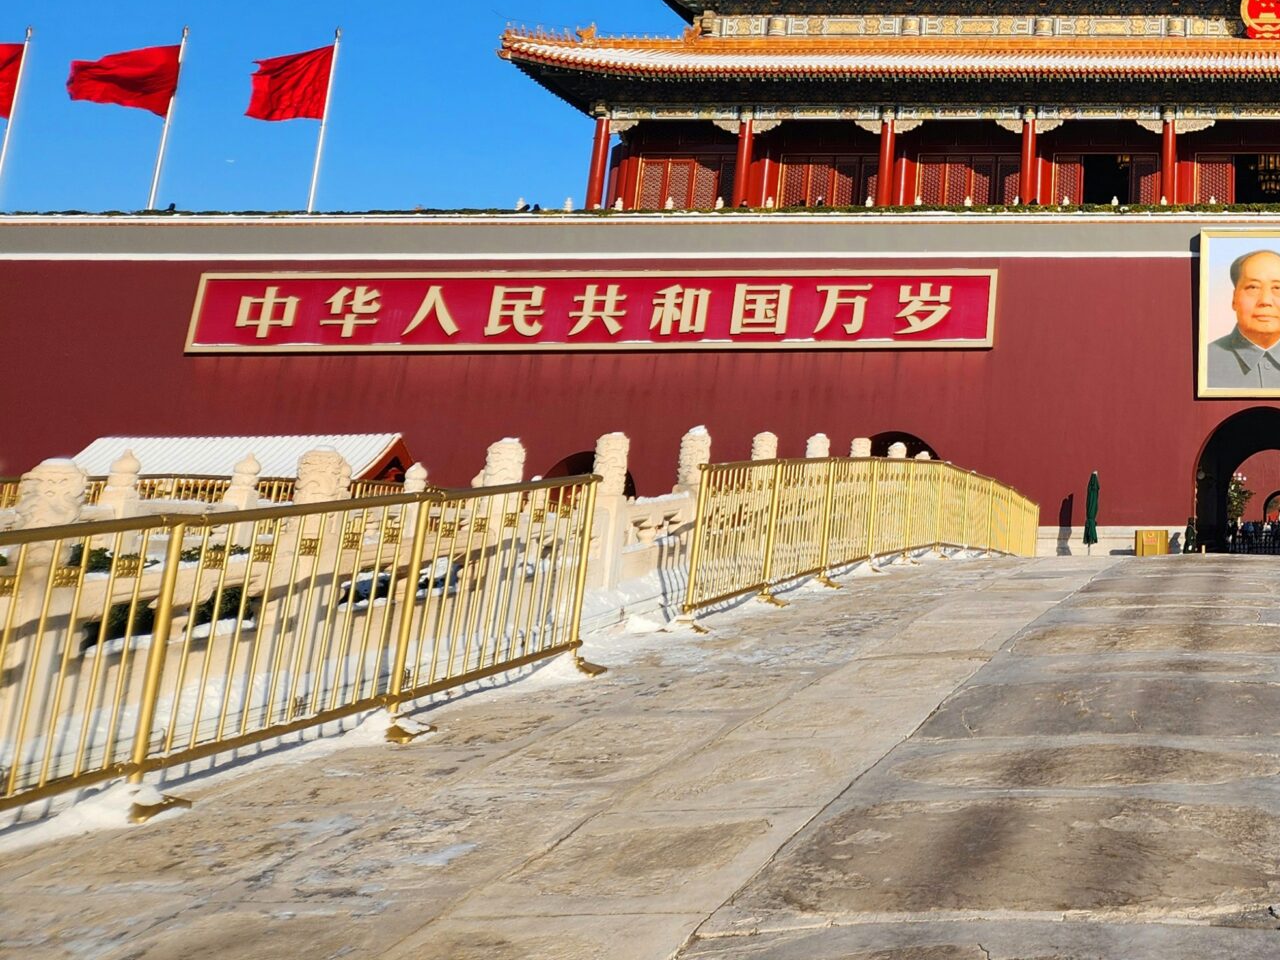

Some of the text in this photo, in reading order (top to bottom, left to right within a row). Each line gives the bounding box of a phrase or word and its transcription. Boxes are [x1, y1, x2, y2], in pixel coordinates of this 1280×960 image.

[234, 283, 953, 338] 中华人民共和国万岁
